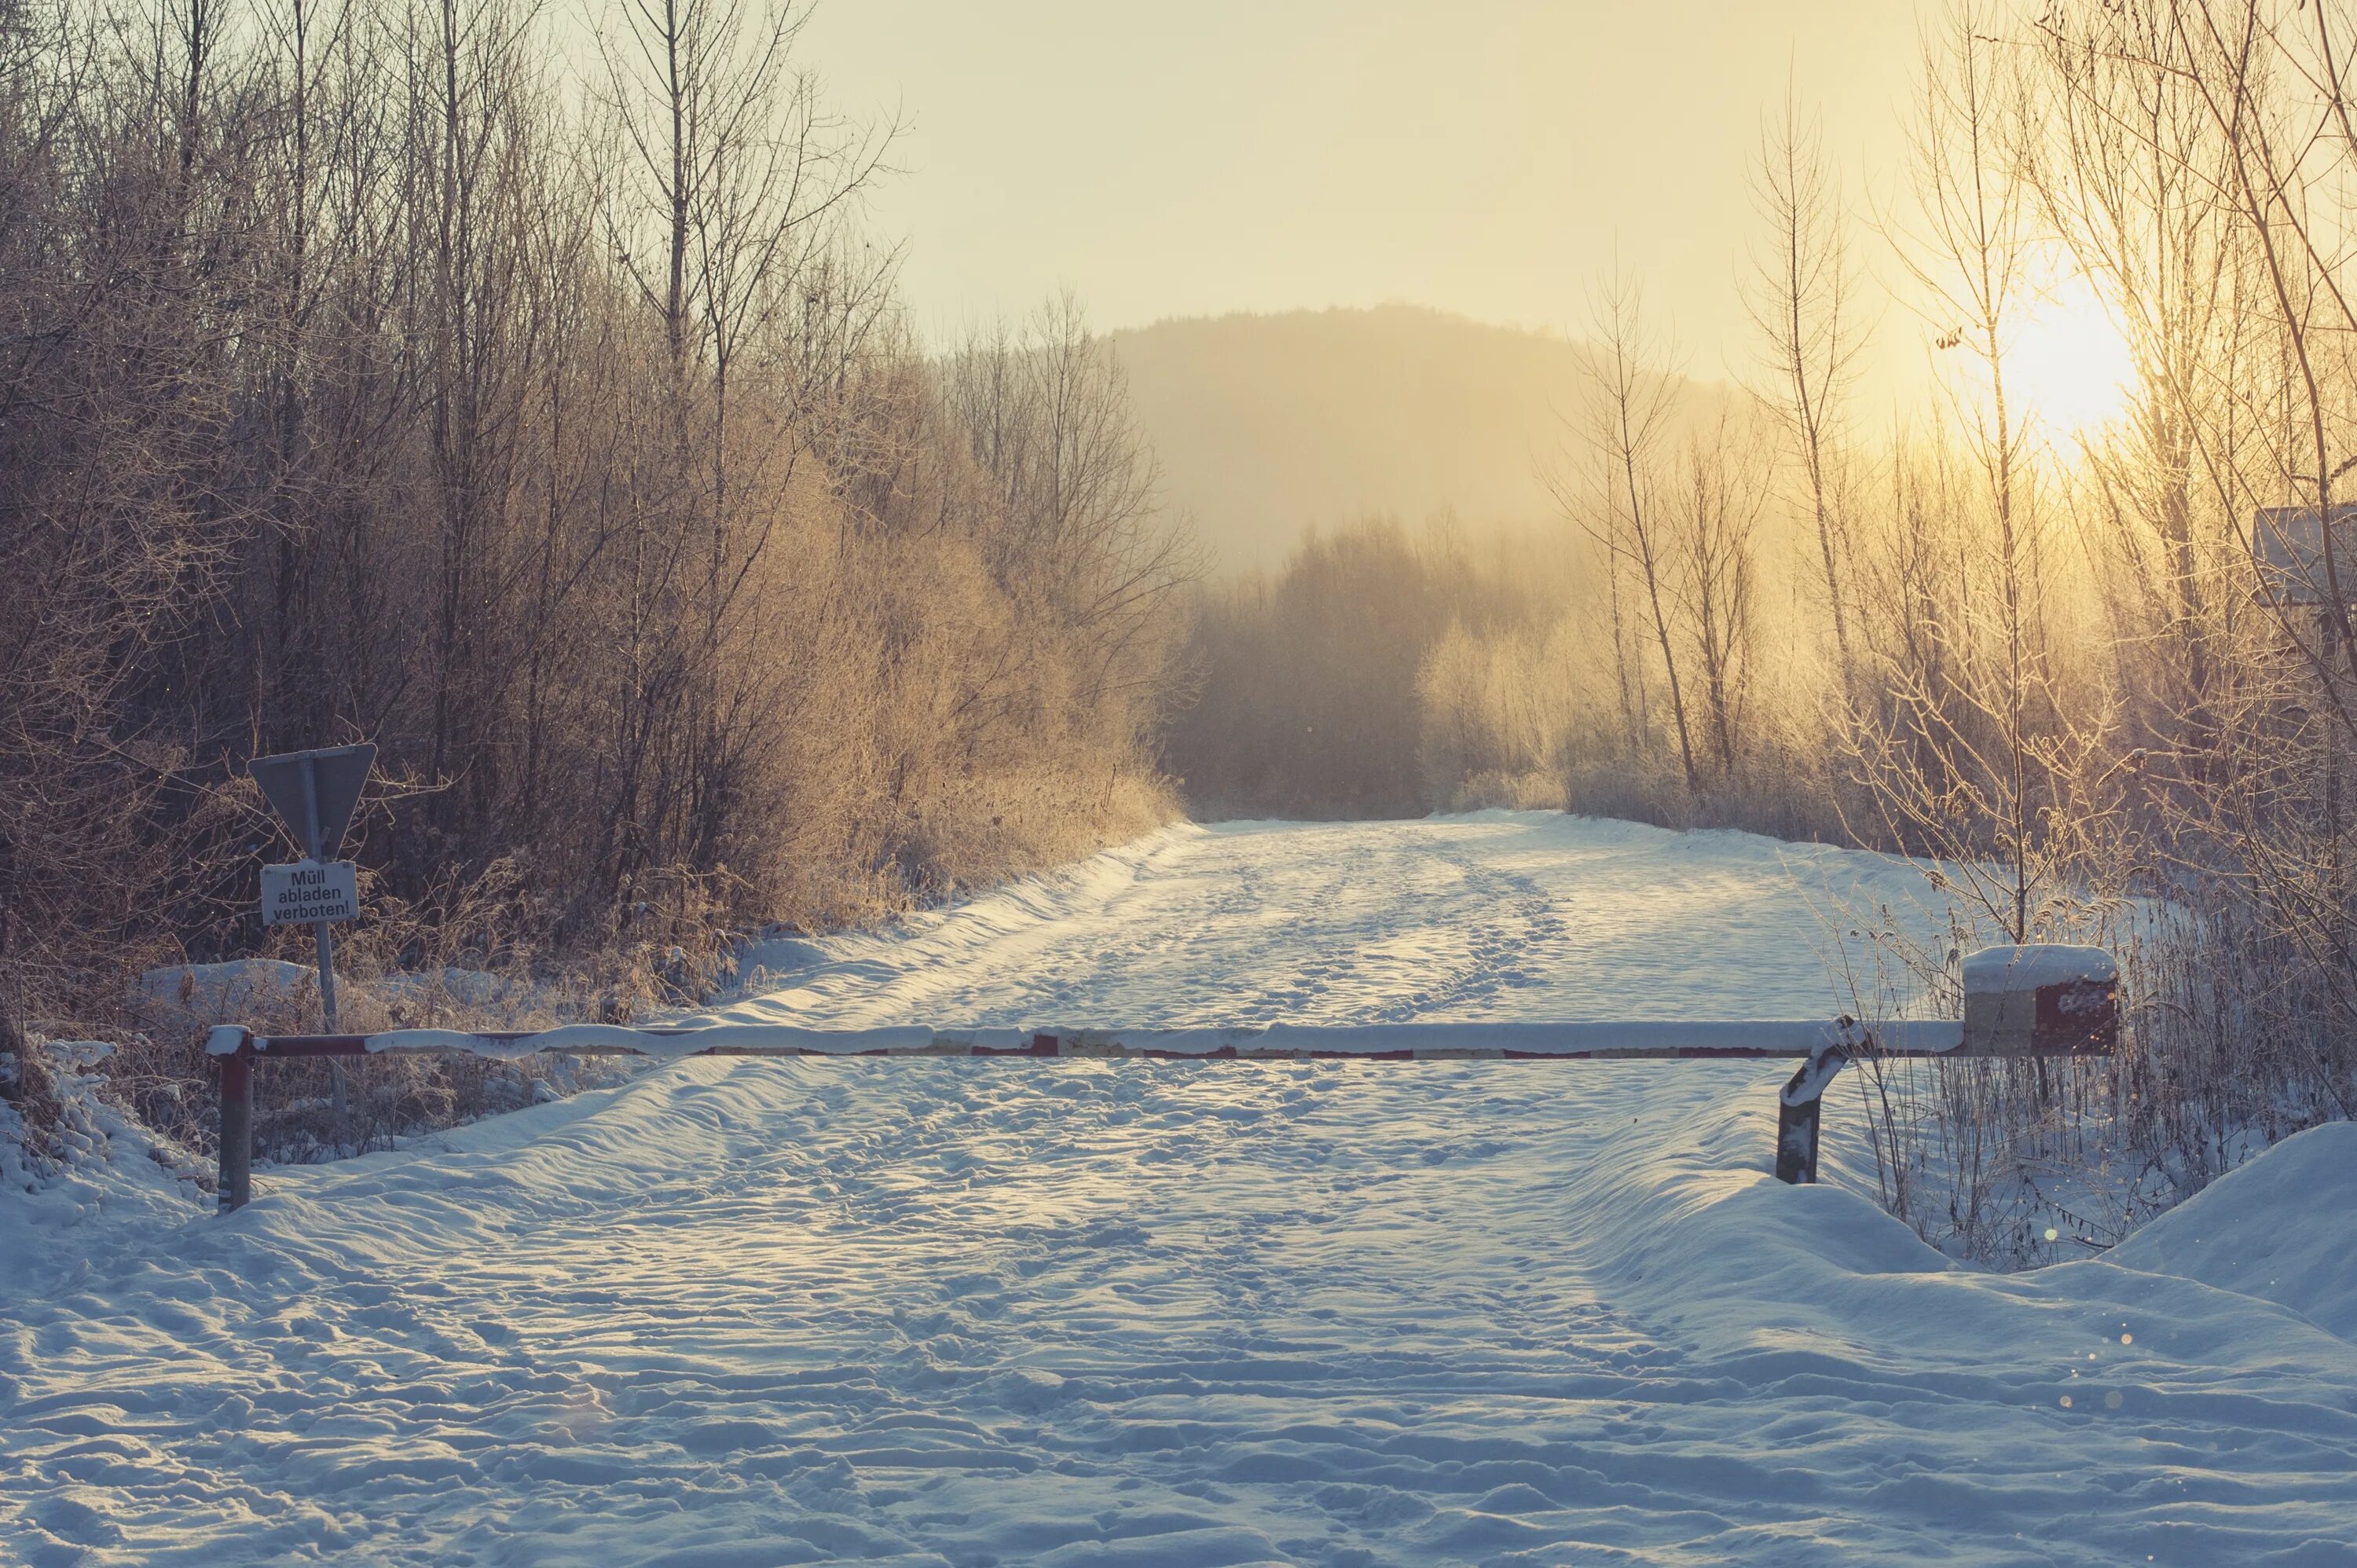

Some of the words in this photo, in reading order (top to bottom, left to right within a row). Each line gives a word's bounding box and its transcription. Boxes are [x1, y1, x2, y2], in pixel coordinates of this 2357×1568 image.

[291, 870, 325, 886] Müll
[279, 886, 341, 903] abladen
[273, 900, 350, 920] verboten!
